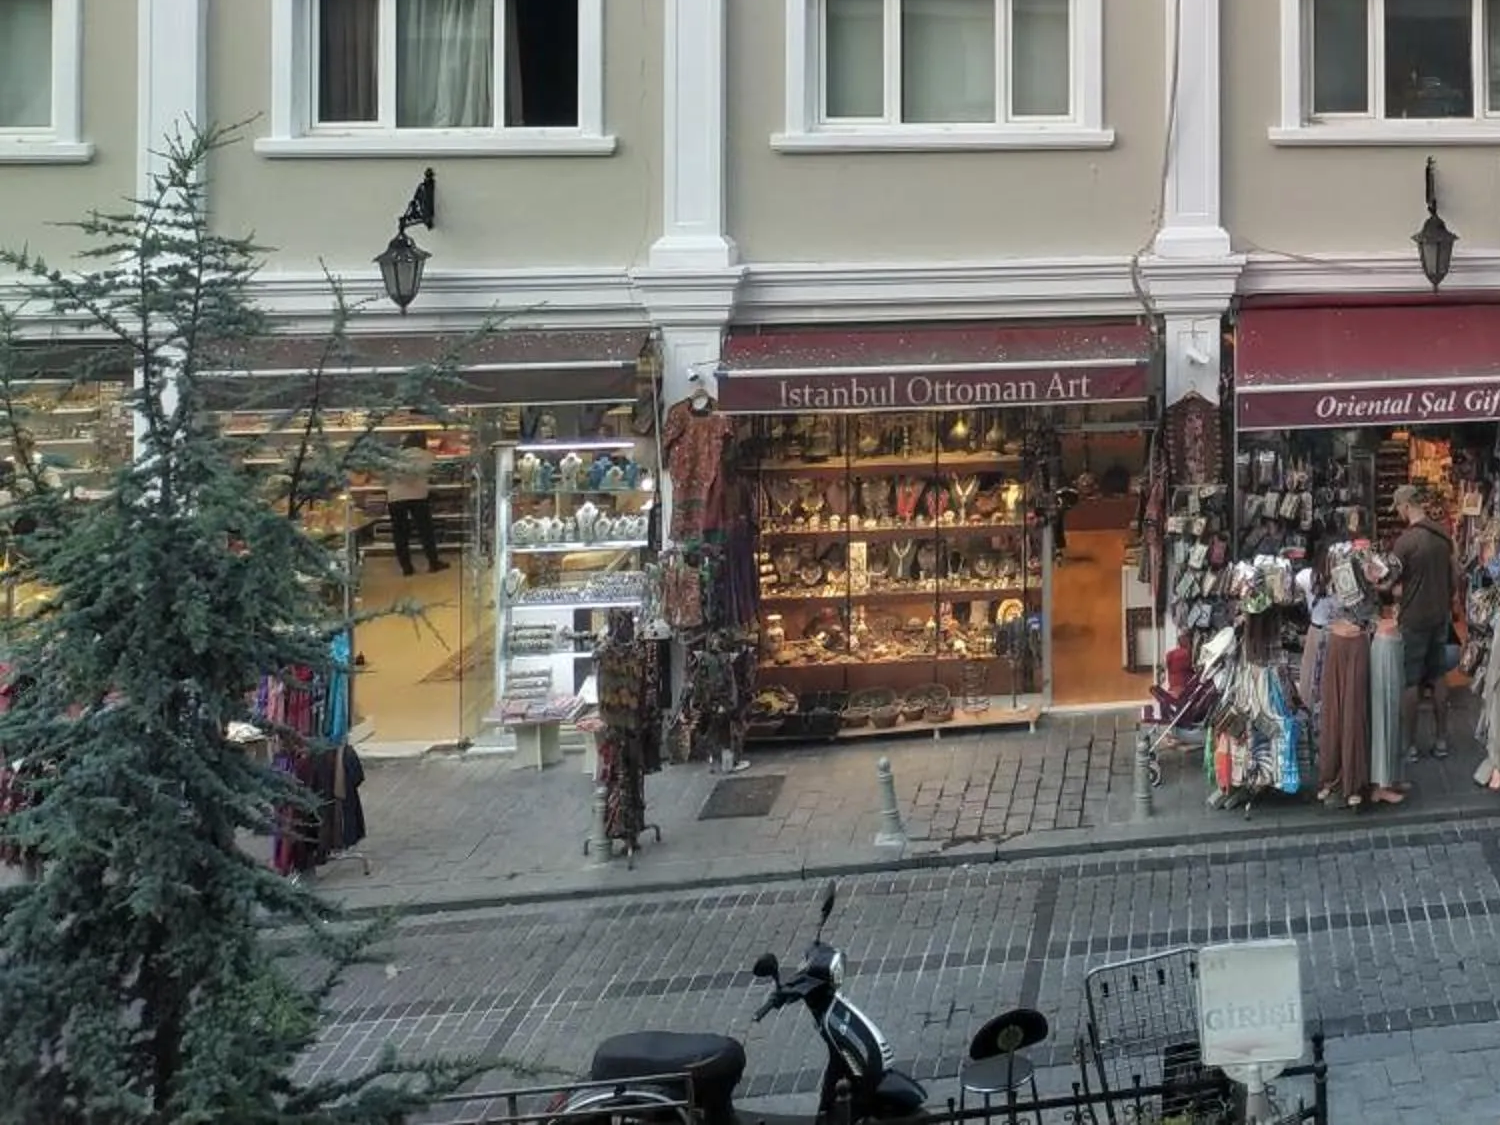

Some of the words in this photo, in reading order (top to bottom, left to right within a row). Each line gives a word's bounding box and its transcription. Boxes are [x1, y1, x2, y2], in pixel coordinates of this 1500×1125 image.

[780, 377, 895, 408] Istanbul
[906, 375, 1036, 405] Ottoman
[1045, 372, 1091, 400] Art
[1315, 393, 1412, 418] Oriental
[1417, 390, 1456, 417] Şal
